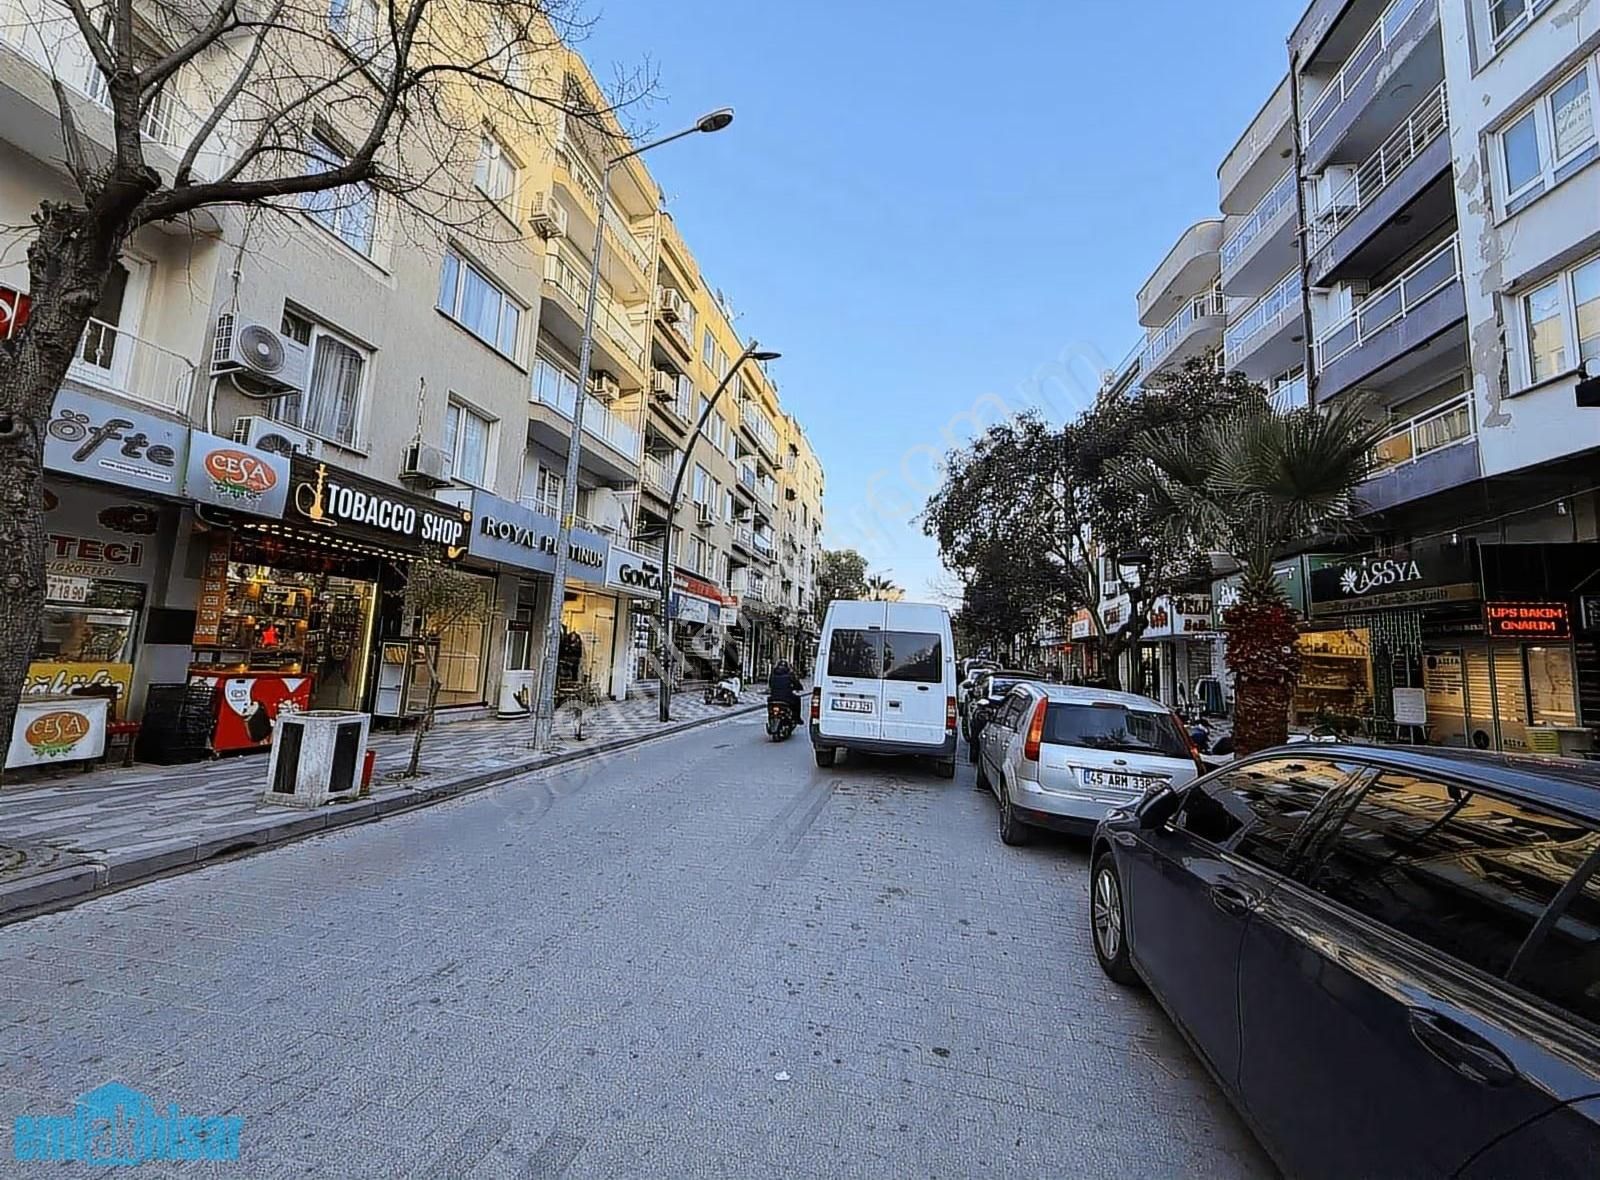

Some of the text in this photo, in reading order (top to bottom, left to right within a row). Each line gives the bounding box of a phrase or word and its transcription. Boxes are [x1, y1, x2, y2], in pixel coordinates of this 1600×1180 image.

[50, 409, 175, 467] öfte
[212, 454, 271, 485] CESA
[328, 484, 463, 546] TOBACCO SHOP
[481, 515, 605, 568] ROYAL PLTINUM
[1491, 607, 1518, 618] UPS
[31, 713, 82, 744] CESA
[1090, 772, 1103, 784] 45
[1108, 774, 1128, 787] ARM
